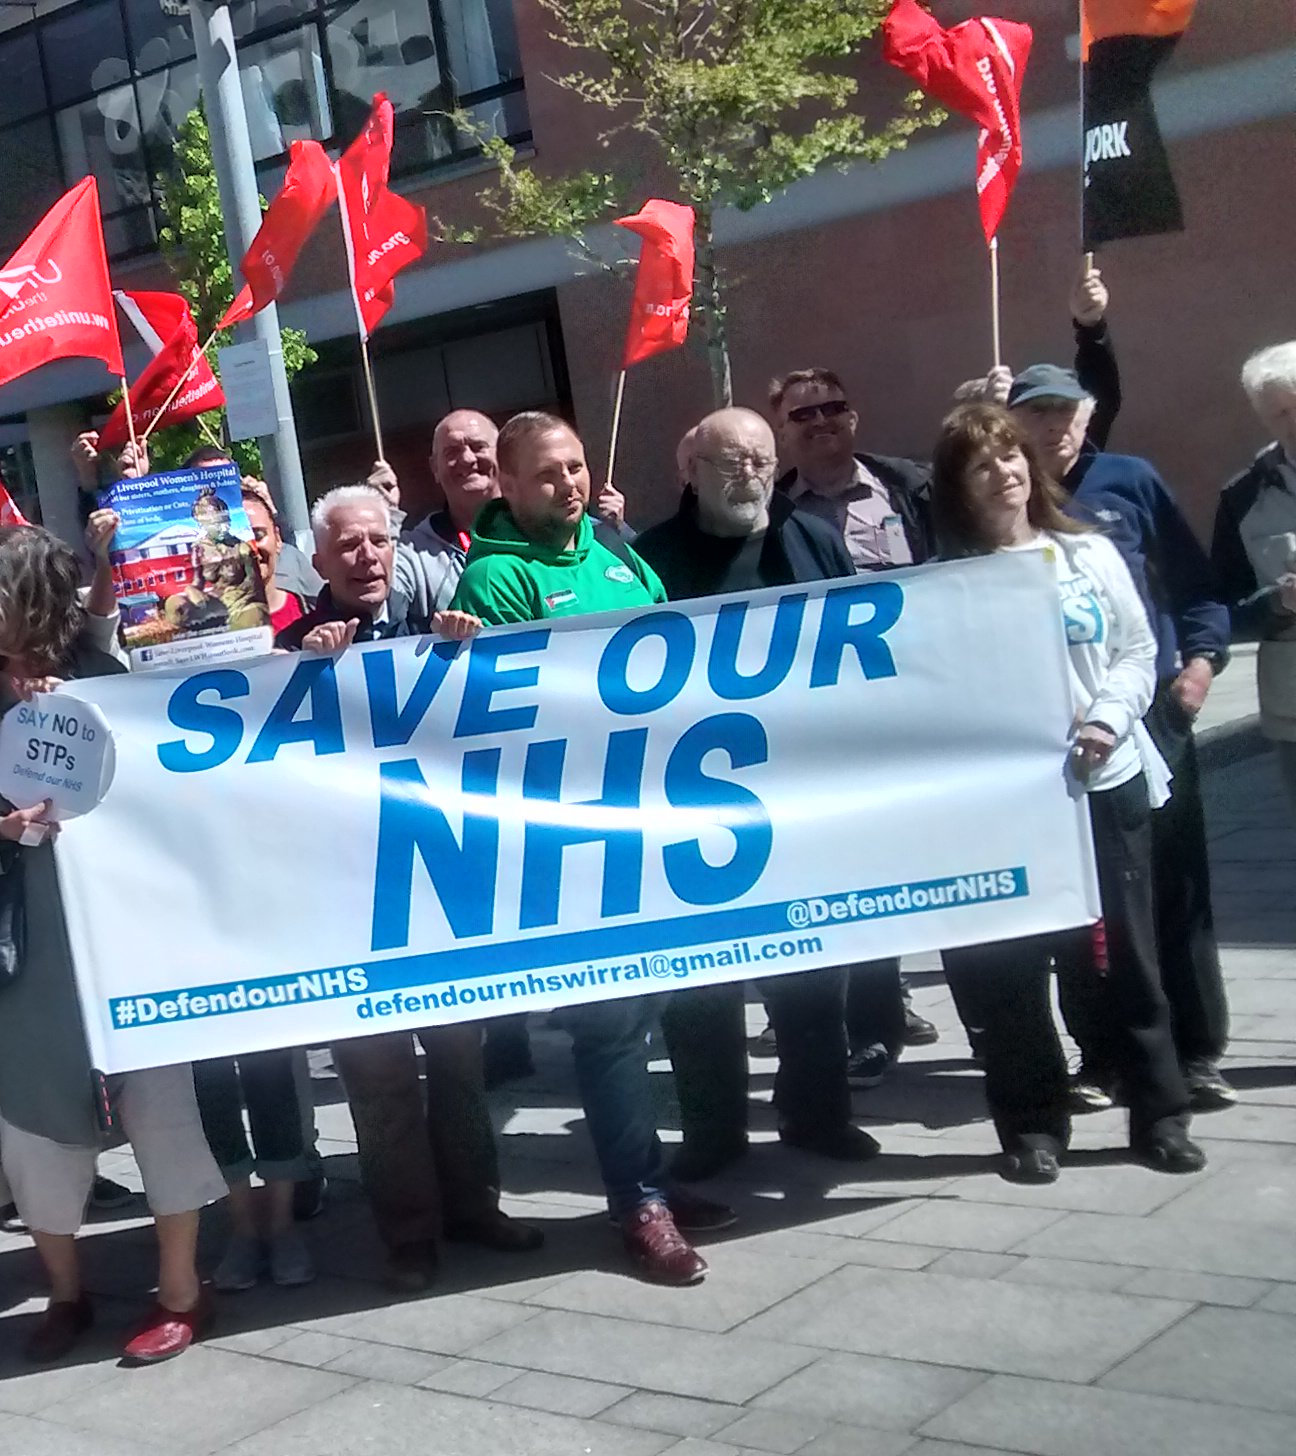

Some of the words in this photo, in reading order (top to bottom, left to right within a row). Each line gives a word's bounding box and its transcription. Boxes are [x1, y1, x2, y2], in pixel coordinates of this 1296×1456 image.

[116, 477, 159, 493] Liverpool
[159, 472, 199, 485] Women's
[200, 467, 236, 481] Hospital
[157, 628, 551, 773] SAVE
[597, 581, 905, 716] OUR
[17, 707, 49, 729] SAY
[52, 713, 78, 737] NO
[82, 724, 95, 742] to
[13, 764, 45, 781] Defend
[46, 775, 62, 785] our
[63, 778, 82, 792] NHS
[26, 738, 75, 771] STPs
[371, 712, 773, 951] NHS
[787, 871, 1016, 928] @DefendourNHS
[116, 967, 368, 1025] #DefendourNHS
[357, 934, 823, 1020] defendournhswirral@gmail.com
